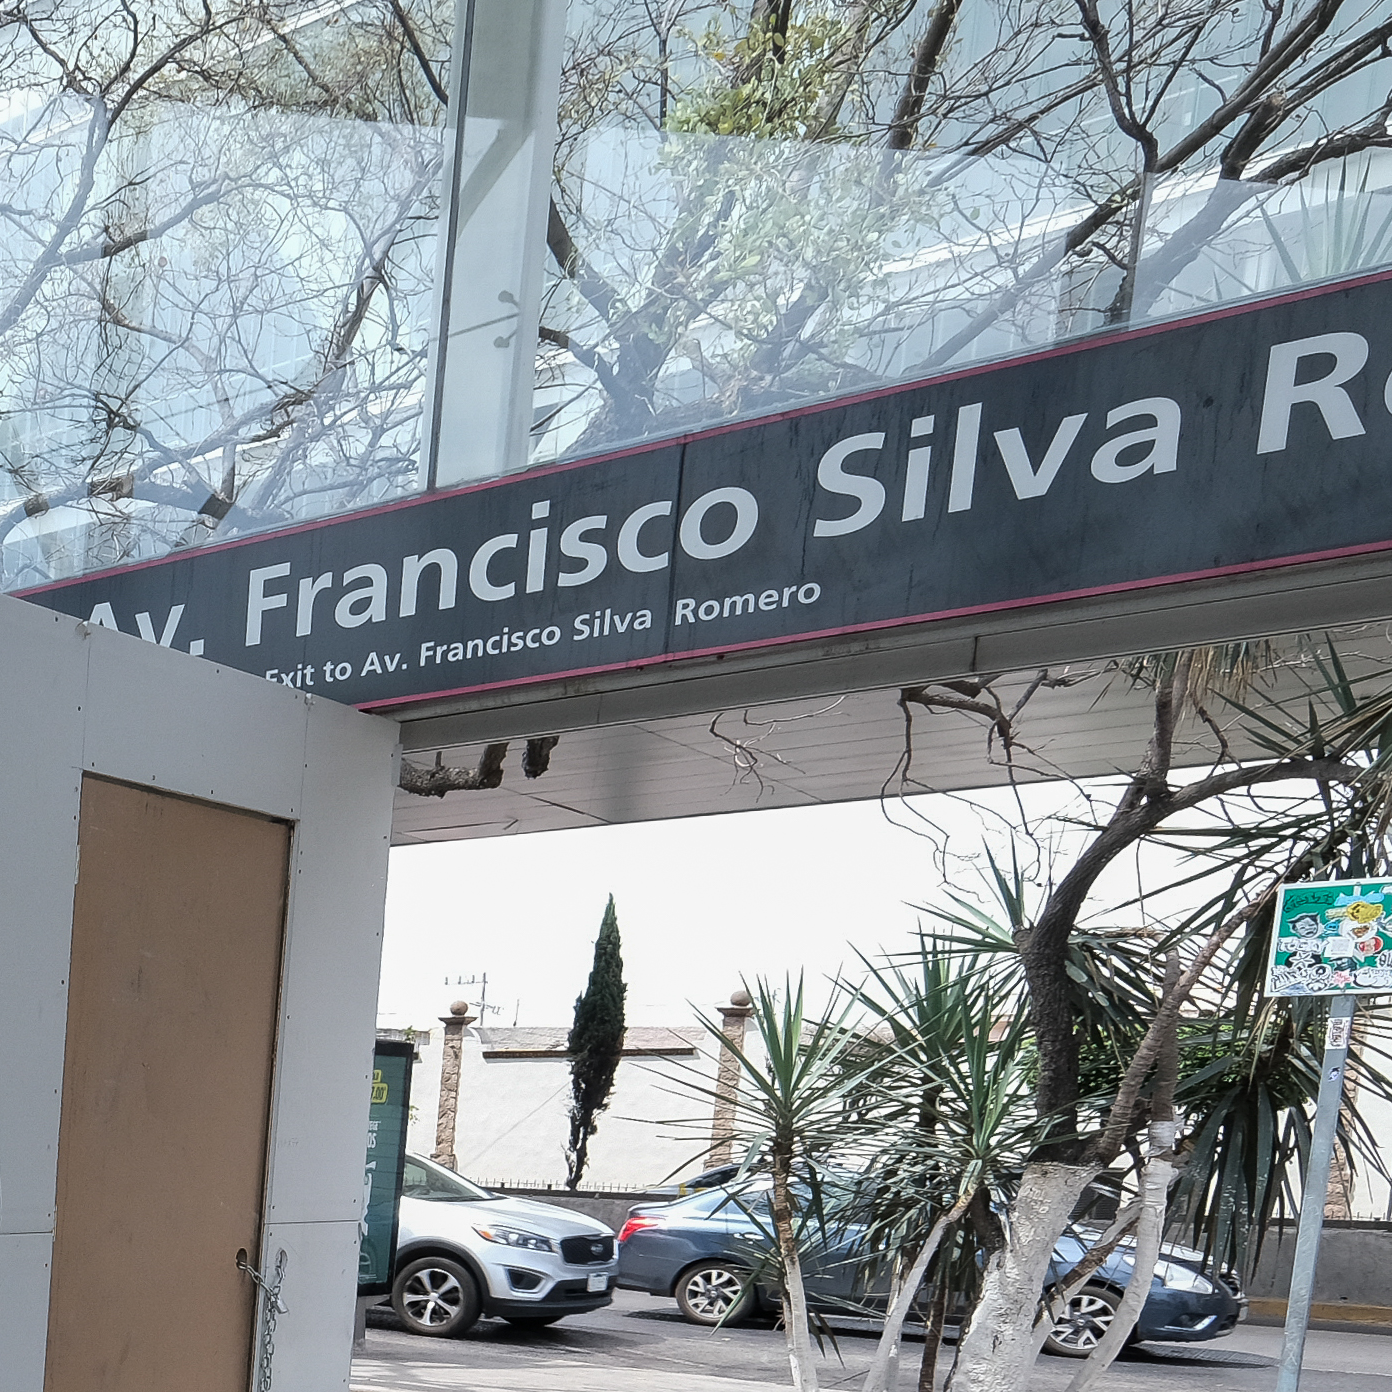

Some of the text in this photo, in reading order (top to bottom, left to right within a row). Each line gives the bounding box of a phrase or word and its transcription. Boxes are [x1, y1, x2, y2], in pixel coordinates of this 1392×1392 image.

[245, 486, 759, 647] Francisco
[813, 401, 1182, 538] Silva
[1256, 331, 1392, 455] R
[323, 660, 352, 682] to
[360, 651, 408, 677] Av.
[419, 625, 561, 667] Francisco
[572, 607, 652, 641] Silva
[674, 582, 821, 626] Romero
